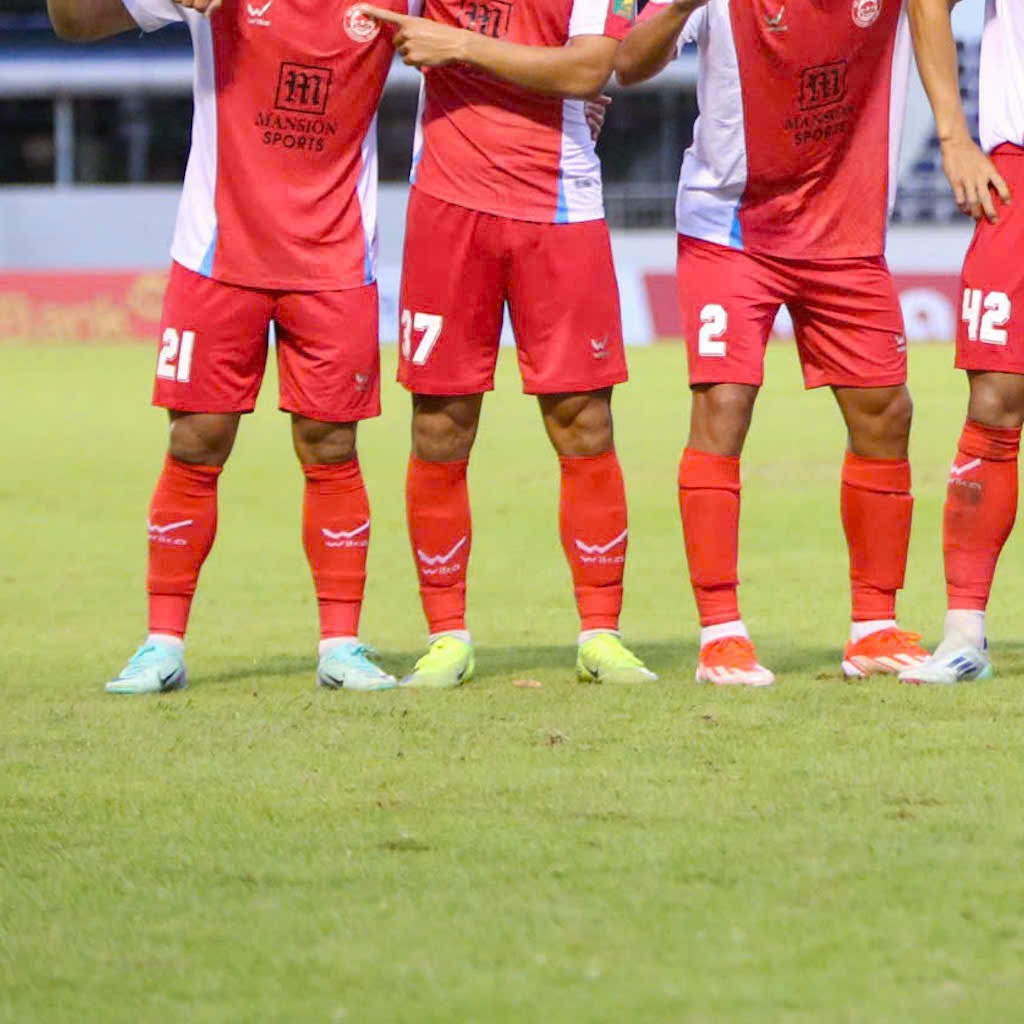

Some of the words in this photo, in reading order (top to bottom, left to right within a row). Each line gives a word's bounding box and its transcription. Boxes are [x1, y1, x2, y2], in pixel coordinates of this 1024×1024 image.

[255, 112, 339, 136] MANSION
[263, 131, 324, 152] SPORTS
[698, 304, 728, 357] 2
[962, 287, 1011, 346] 42
[156, 327, 196, 383] 21
